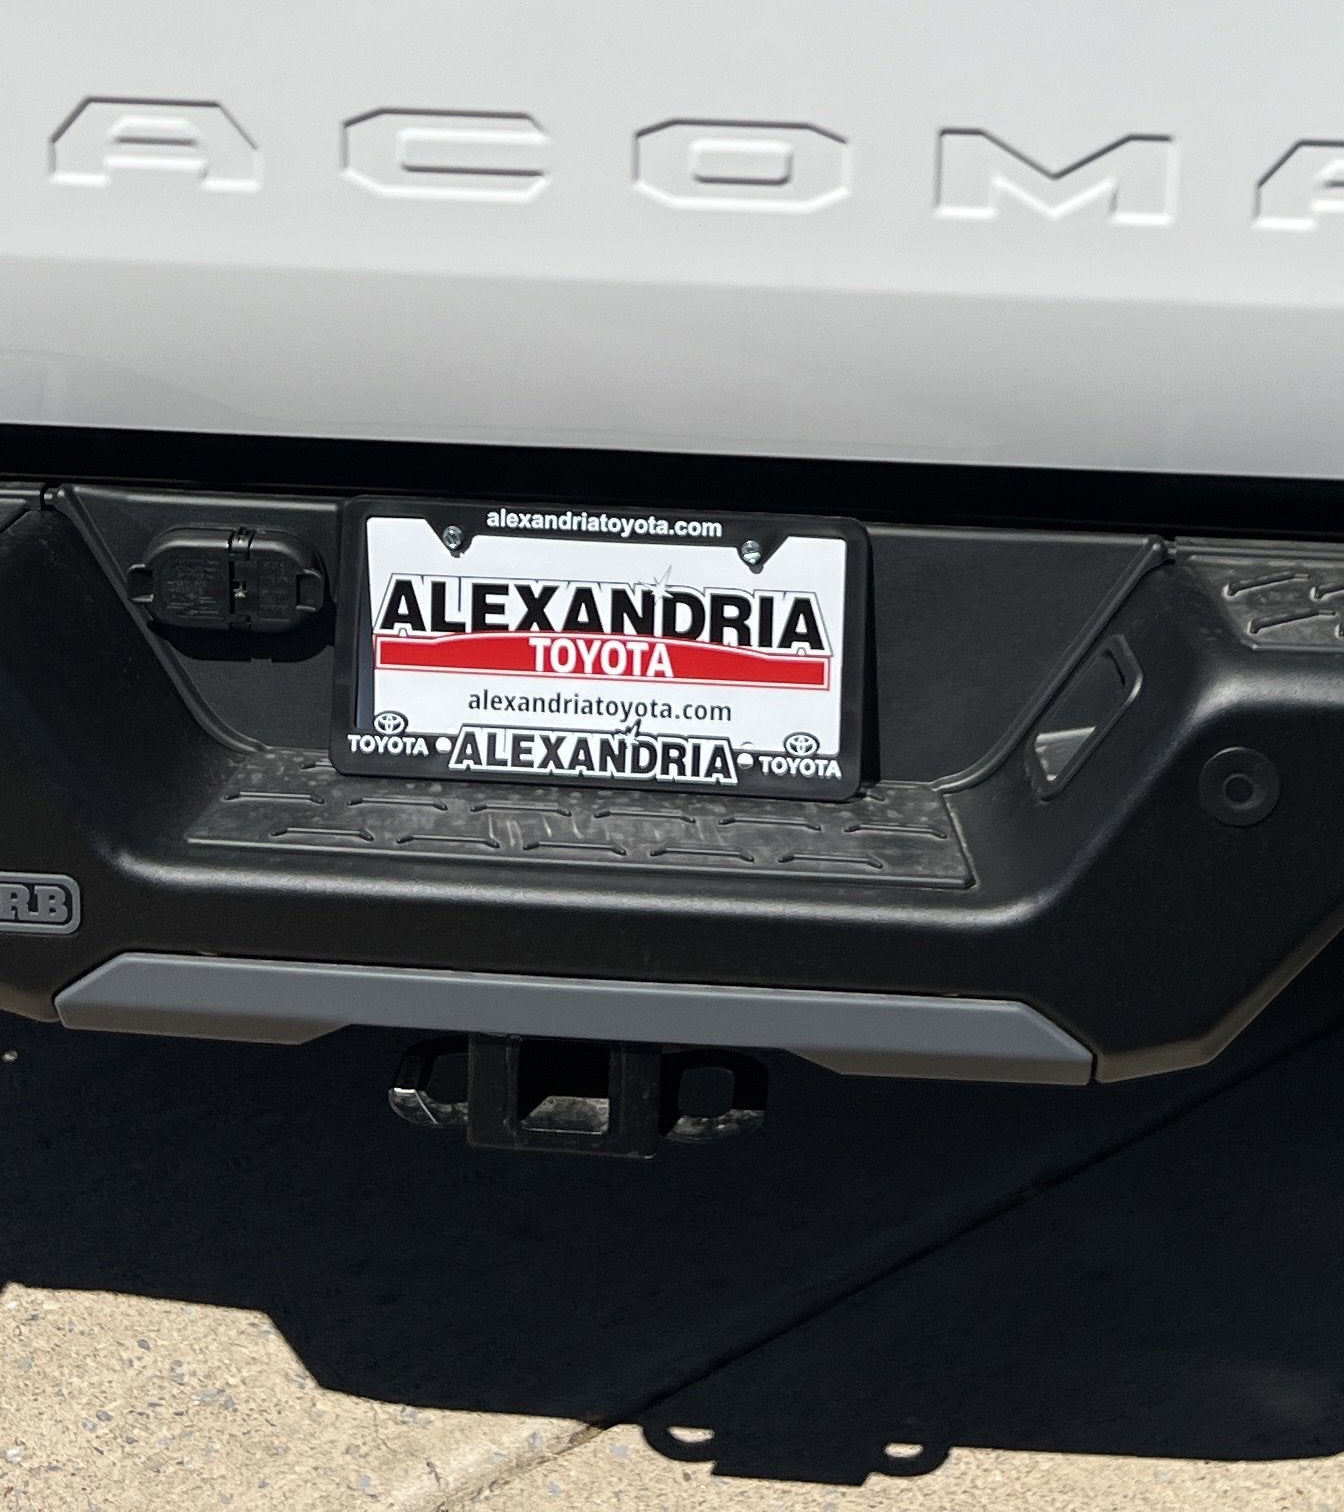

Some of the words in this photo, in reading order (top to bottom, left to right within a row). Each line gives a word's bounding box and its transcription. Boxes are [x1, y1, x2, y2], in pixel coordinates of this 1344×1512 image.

[486, 508, 722, 539] alexandriatoyota.com
[378, 577, 826, 652] ALEXANDRIA
[529, 636, 674, 678] TOYOTA
[468, 689, 732, 723] alexandriatoyota.com
[348, 734, 429, 757] TOYOTA
[455, 727, 734, 780] ALEXANDRIA
[759, 755, 842, 779] TOYOTA
